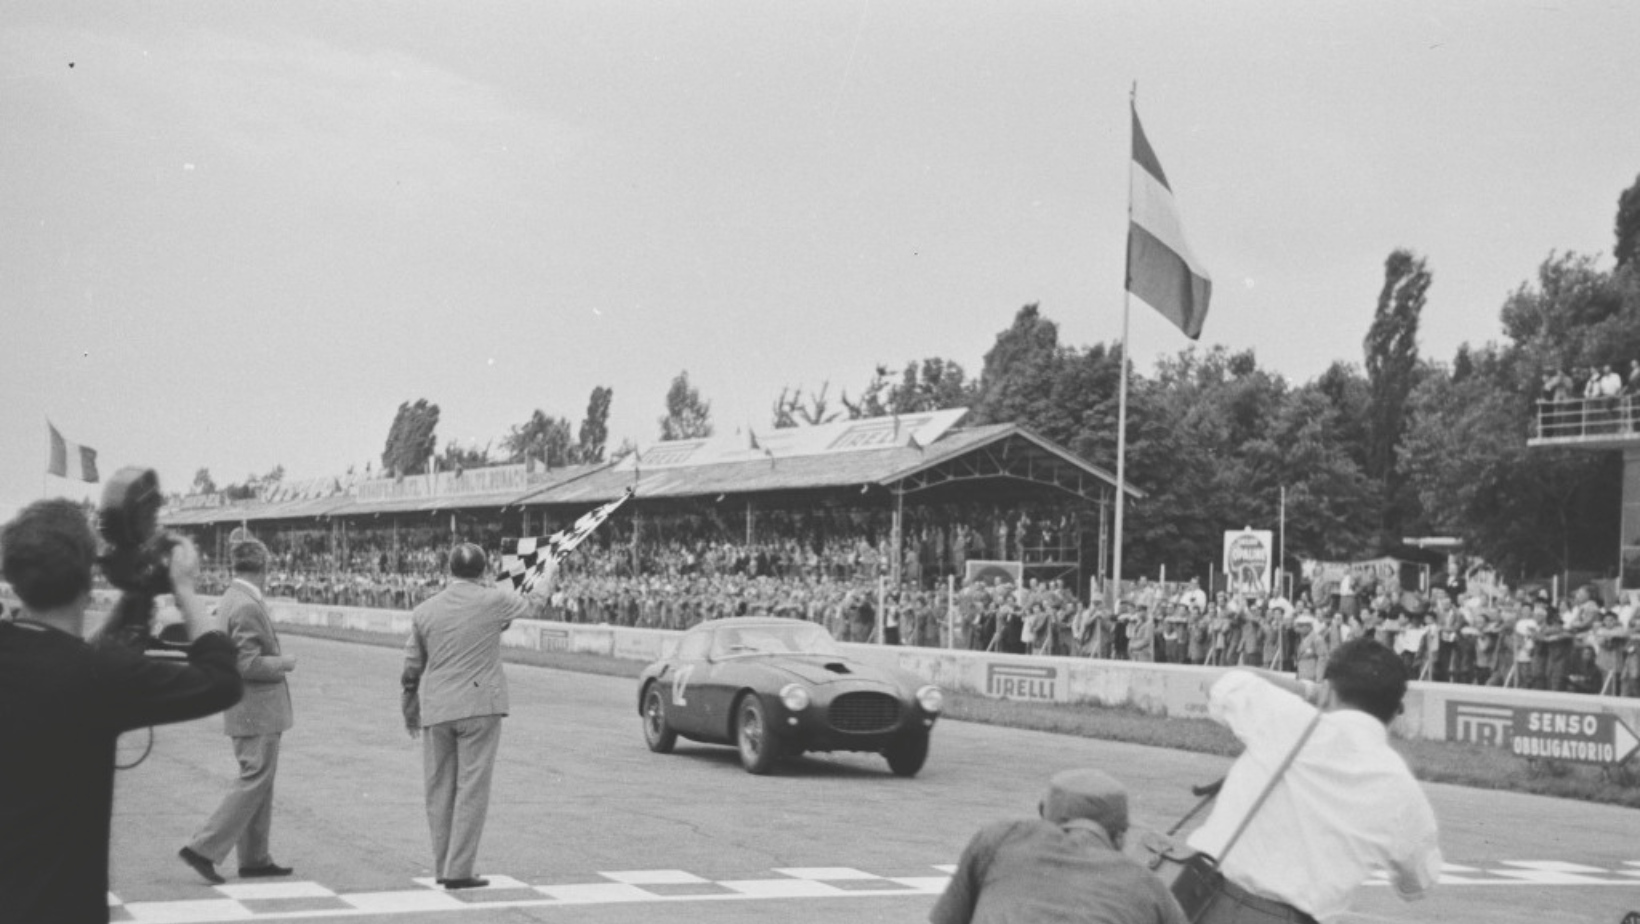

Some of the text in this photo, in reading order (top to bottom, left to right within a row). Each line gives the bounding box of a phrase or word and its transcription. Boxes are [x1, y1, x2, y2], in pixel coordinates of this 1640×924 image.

[986, 662, 1057, 700] PIRELLI
[1528, 711, 1598, 736] SENSO
[1513, 736, 1613, 762] OBBLIGATORIO
